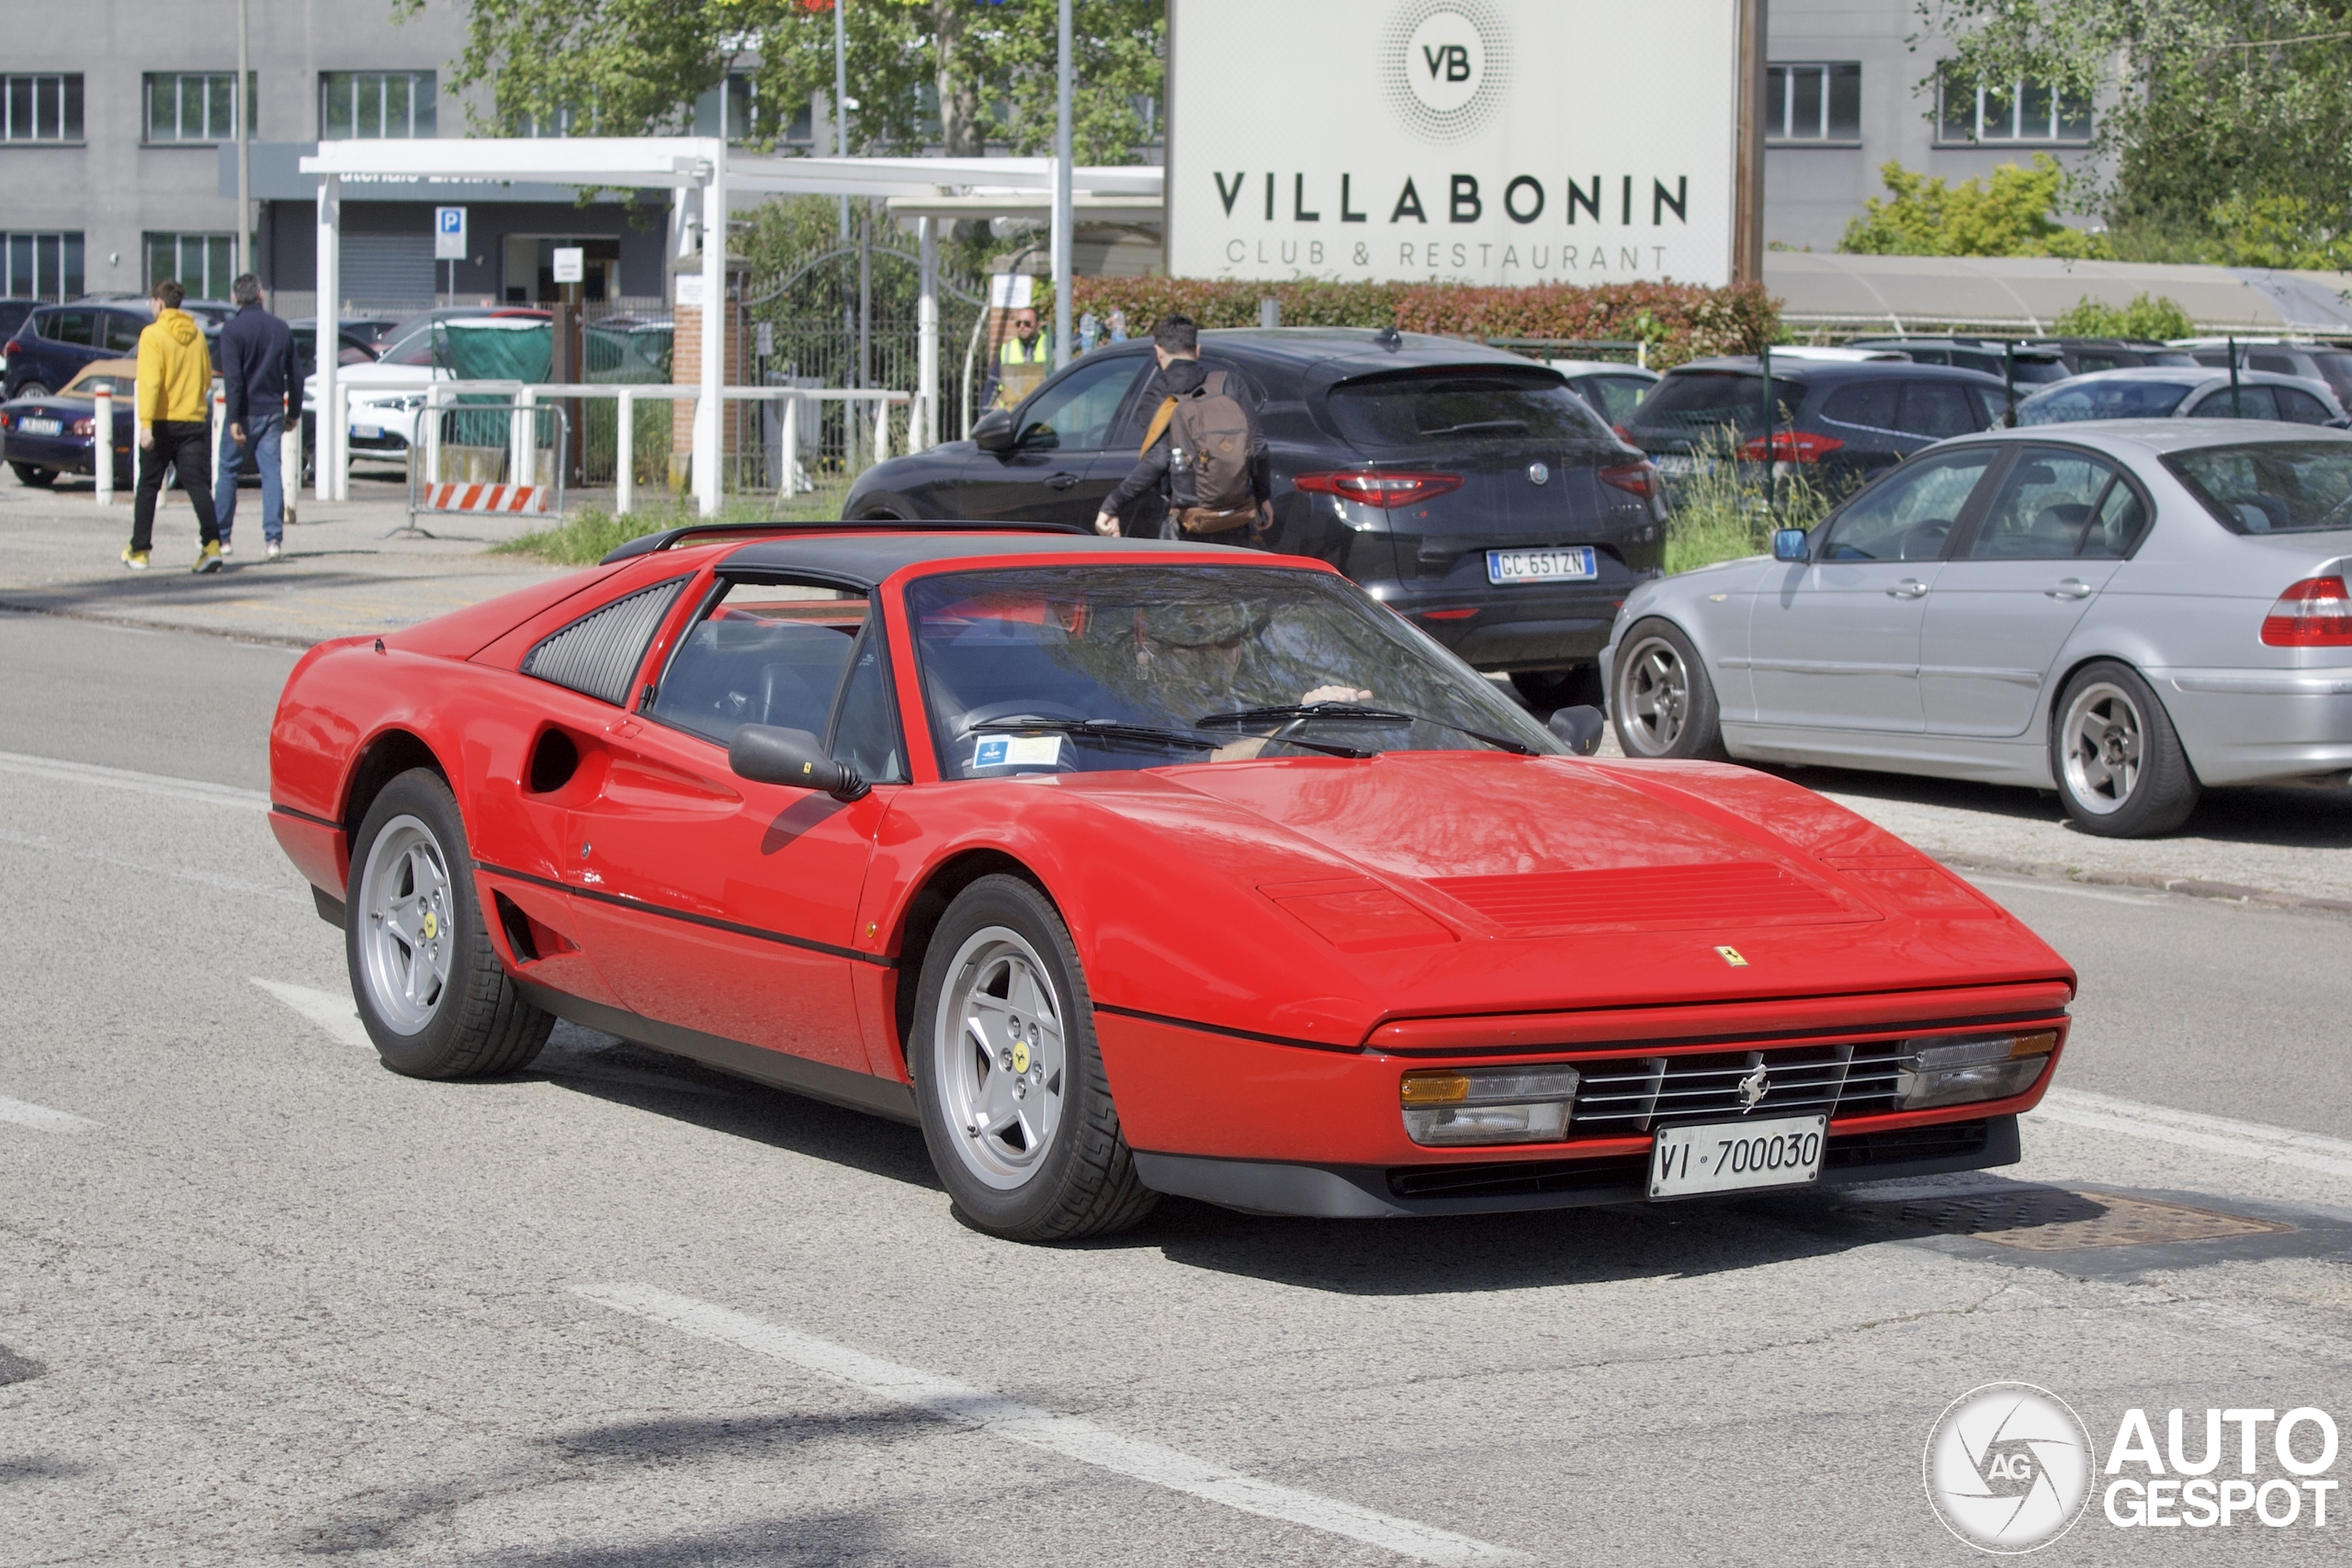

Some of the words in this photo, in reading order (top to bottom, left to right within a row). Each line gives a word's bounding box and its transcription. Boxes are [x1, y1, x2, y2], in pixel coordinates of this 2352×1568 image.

[1423, 45, 1471, 83] VB
[1214, 172, 1687, 226] VILLABONIN
[446, 212, 458, 231] P
[1226, 239, 1324, 265] CLUB
[1352, 242, 1369, 266] &
[1399, 242, 1667, 271] RESTAURANT
[1501, 554, 1523, 575] GC
[1529, 552, 1583, 574] 651ZN
[1660, 1144, 1690, 1179] VI
[1713, 1132, 1819, 1176] 700030
